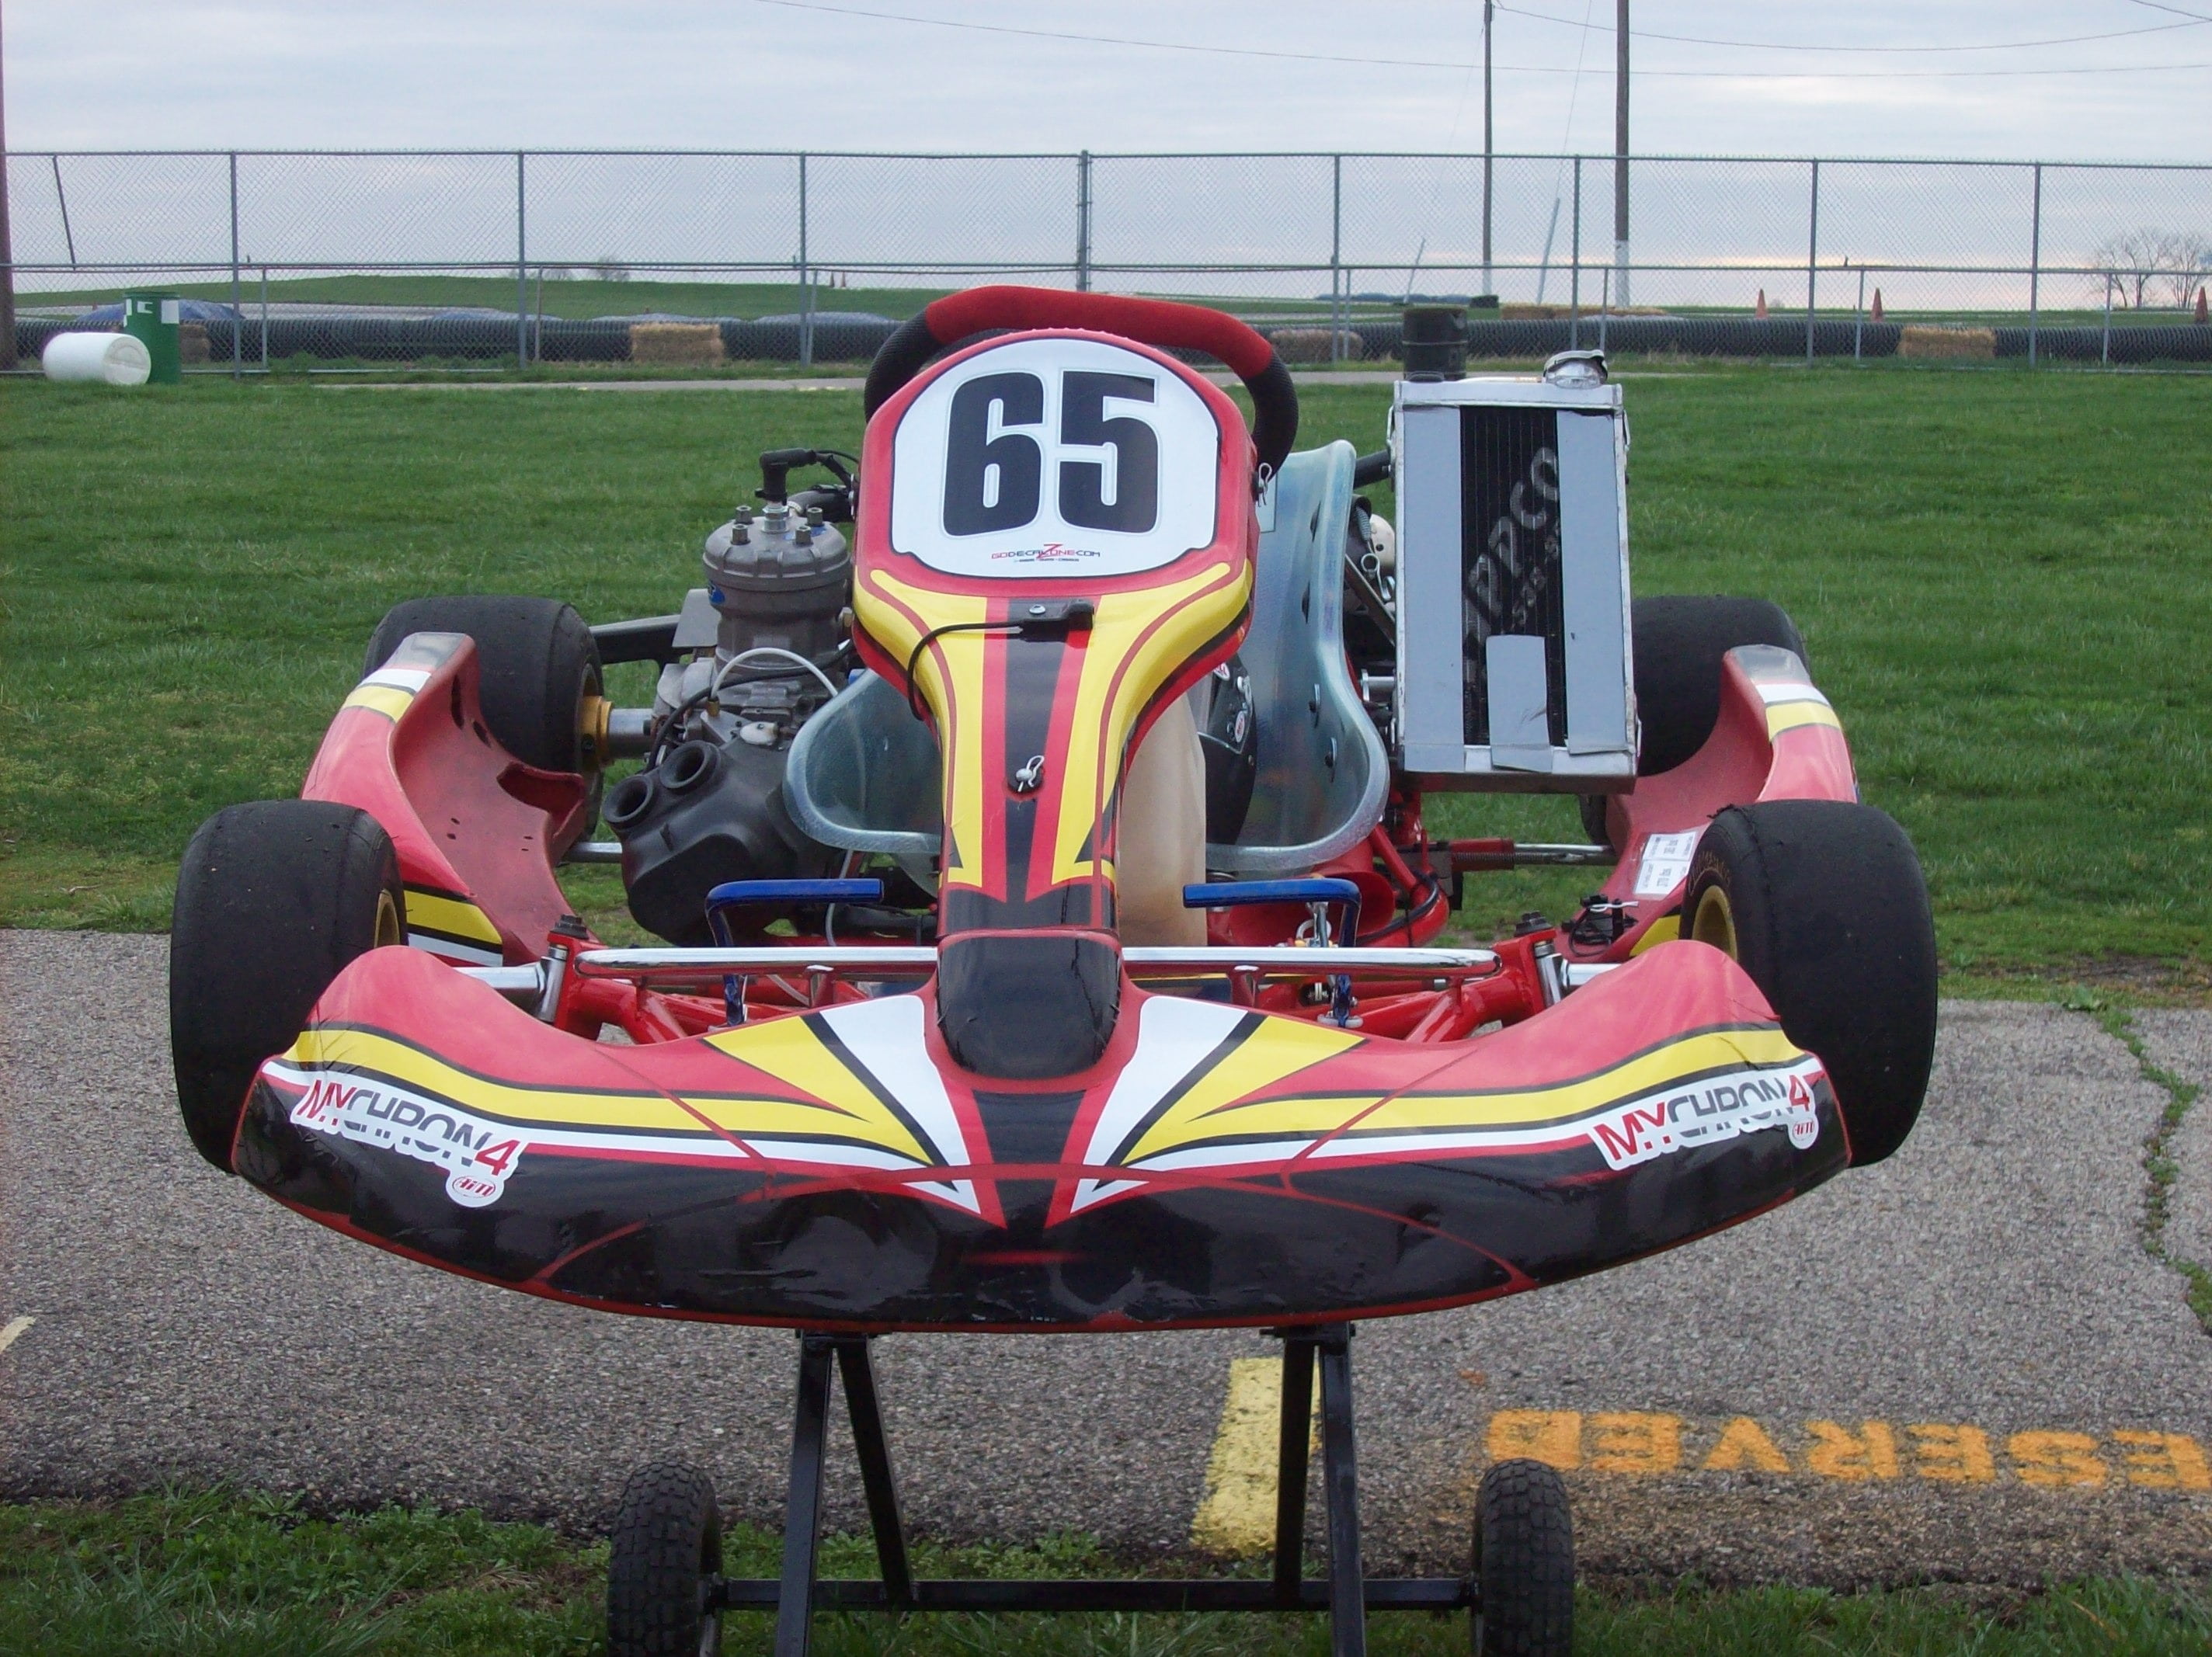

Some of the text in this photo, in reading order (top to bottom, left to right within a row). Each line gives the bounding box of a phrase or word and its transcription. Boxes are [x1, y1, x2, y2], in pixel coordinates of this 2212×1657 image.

[943, 370, 1158, 536] 65
[297, 1079, 520, 1176] MYCHRON4
[1593, 1075, 1810, 1162] MYCHRON4
